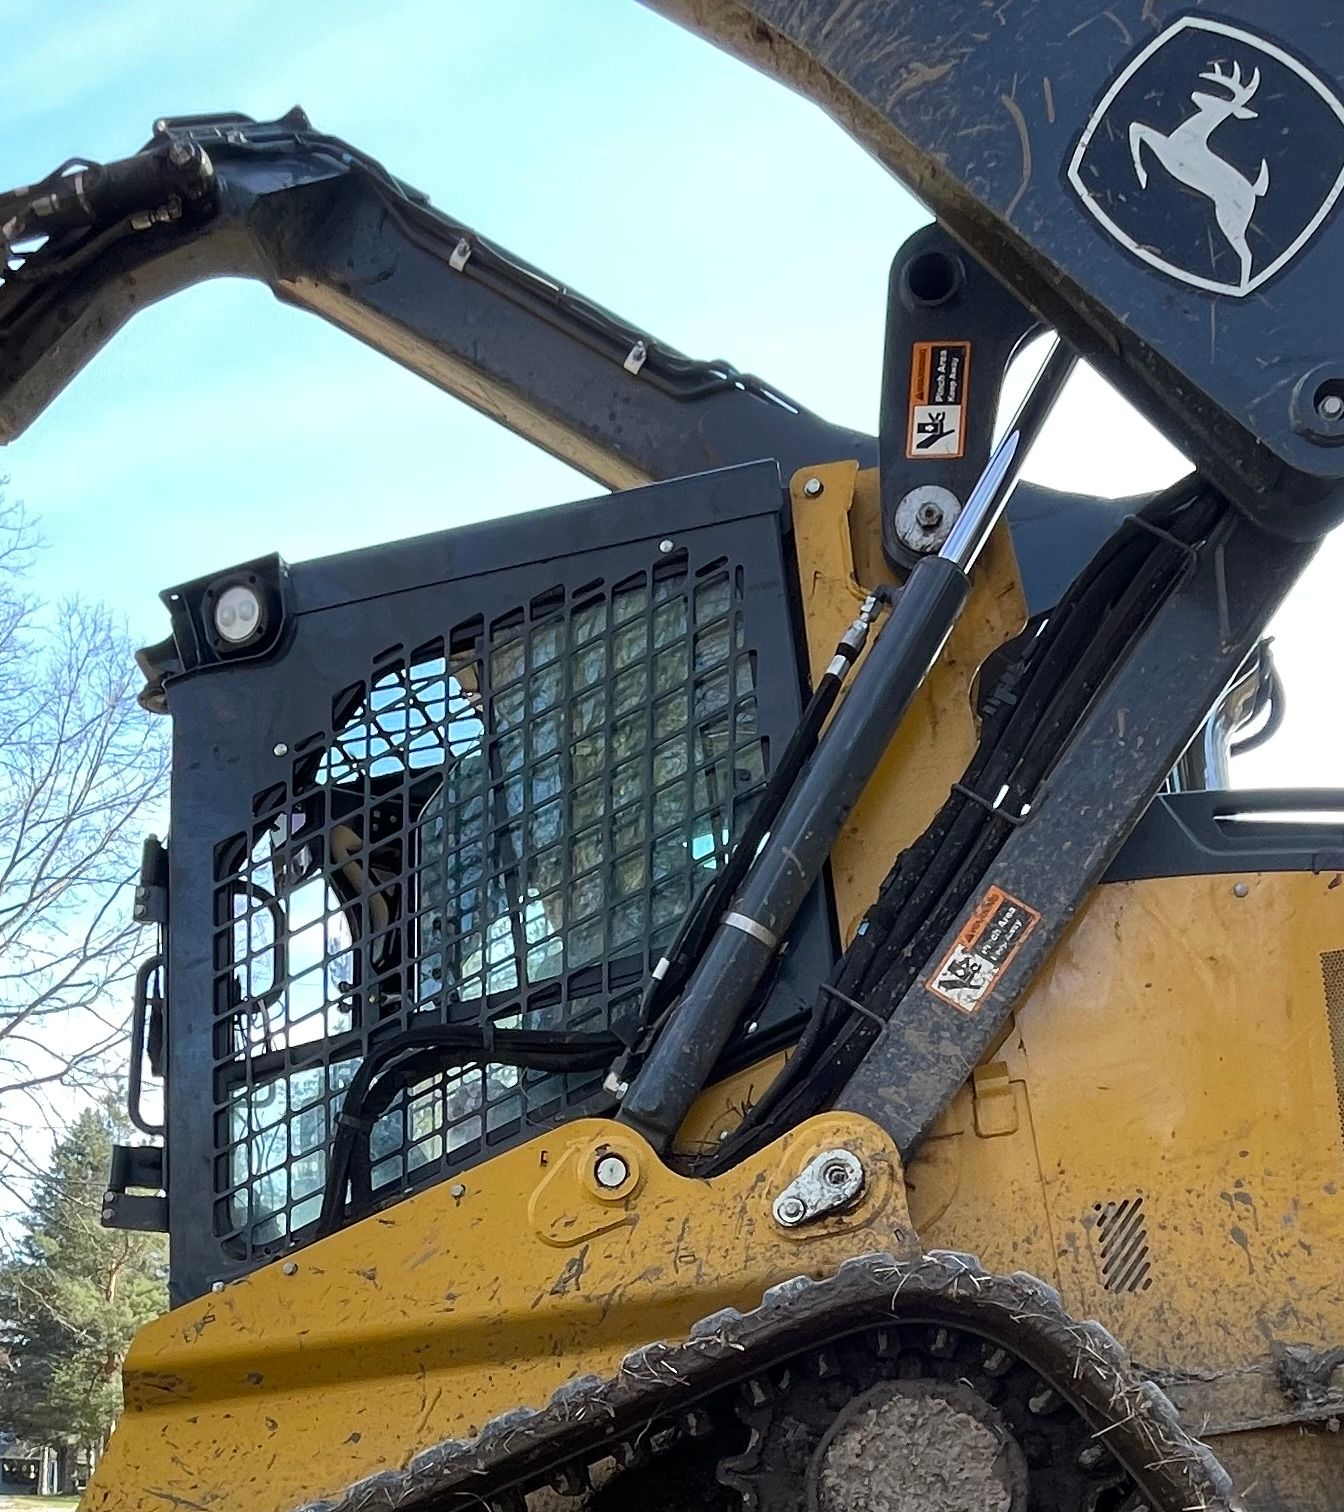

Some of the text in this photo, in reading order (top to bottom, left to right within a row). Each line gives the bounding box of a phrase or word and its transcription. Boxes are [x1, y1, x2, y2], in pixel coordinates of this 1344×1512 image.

[935, 350, 947, 402] Pinch Area
[947, 357, 959, 402] Keep Away
[981, 906, 1017, 955] Pich Area
